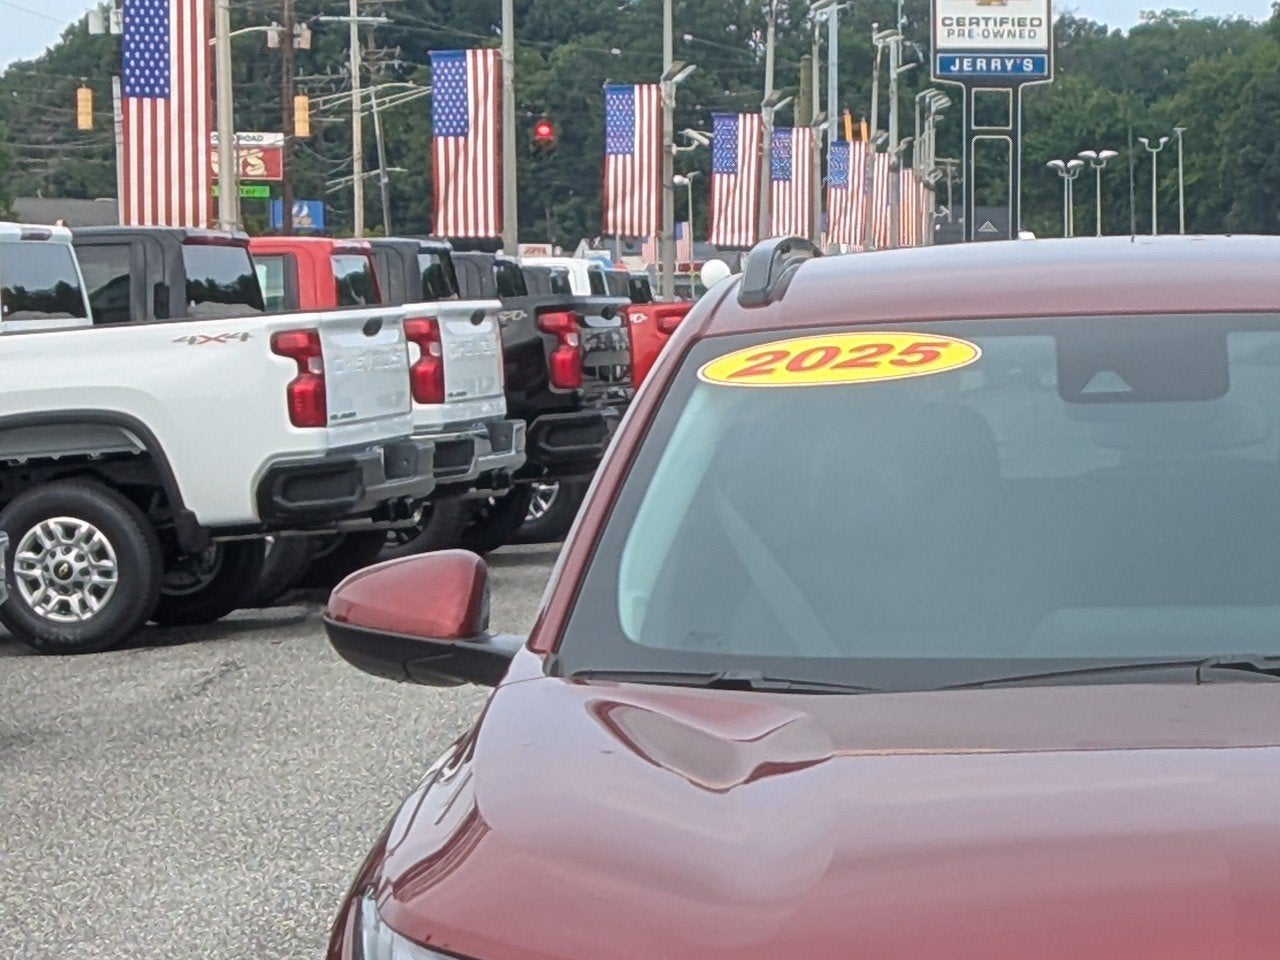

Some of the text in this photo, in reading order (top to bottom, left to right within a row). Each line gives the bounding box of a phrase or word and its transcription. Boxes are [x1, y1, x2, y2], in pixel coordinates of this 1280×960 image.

[941, 16, 1043, 28] CERTIFIED
[946, 28, 1037, 40] PRE-OWNED
[950, 57, 1034, 72] JERRY'S
[726, 342, 952, 380] 2025
